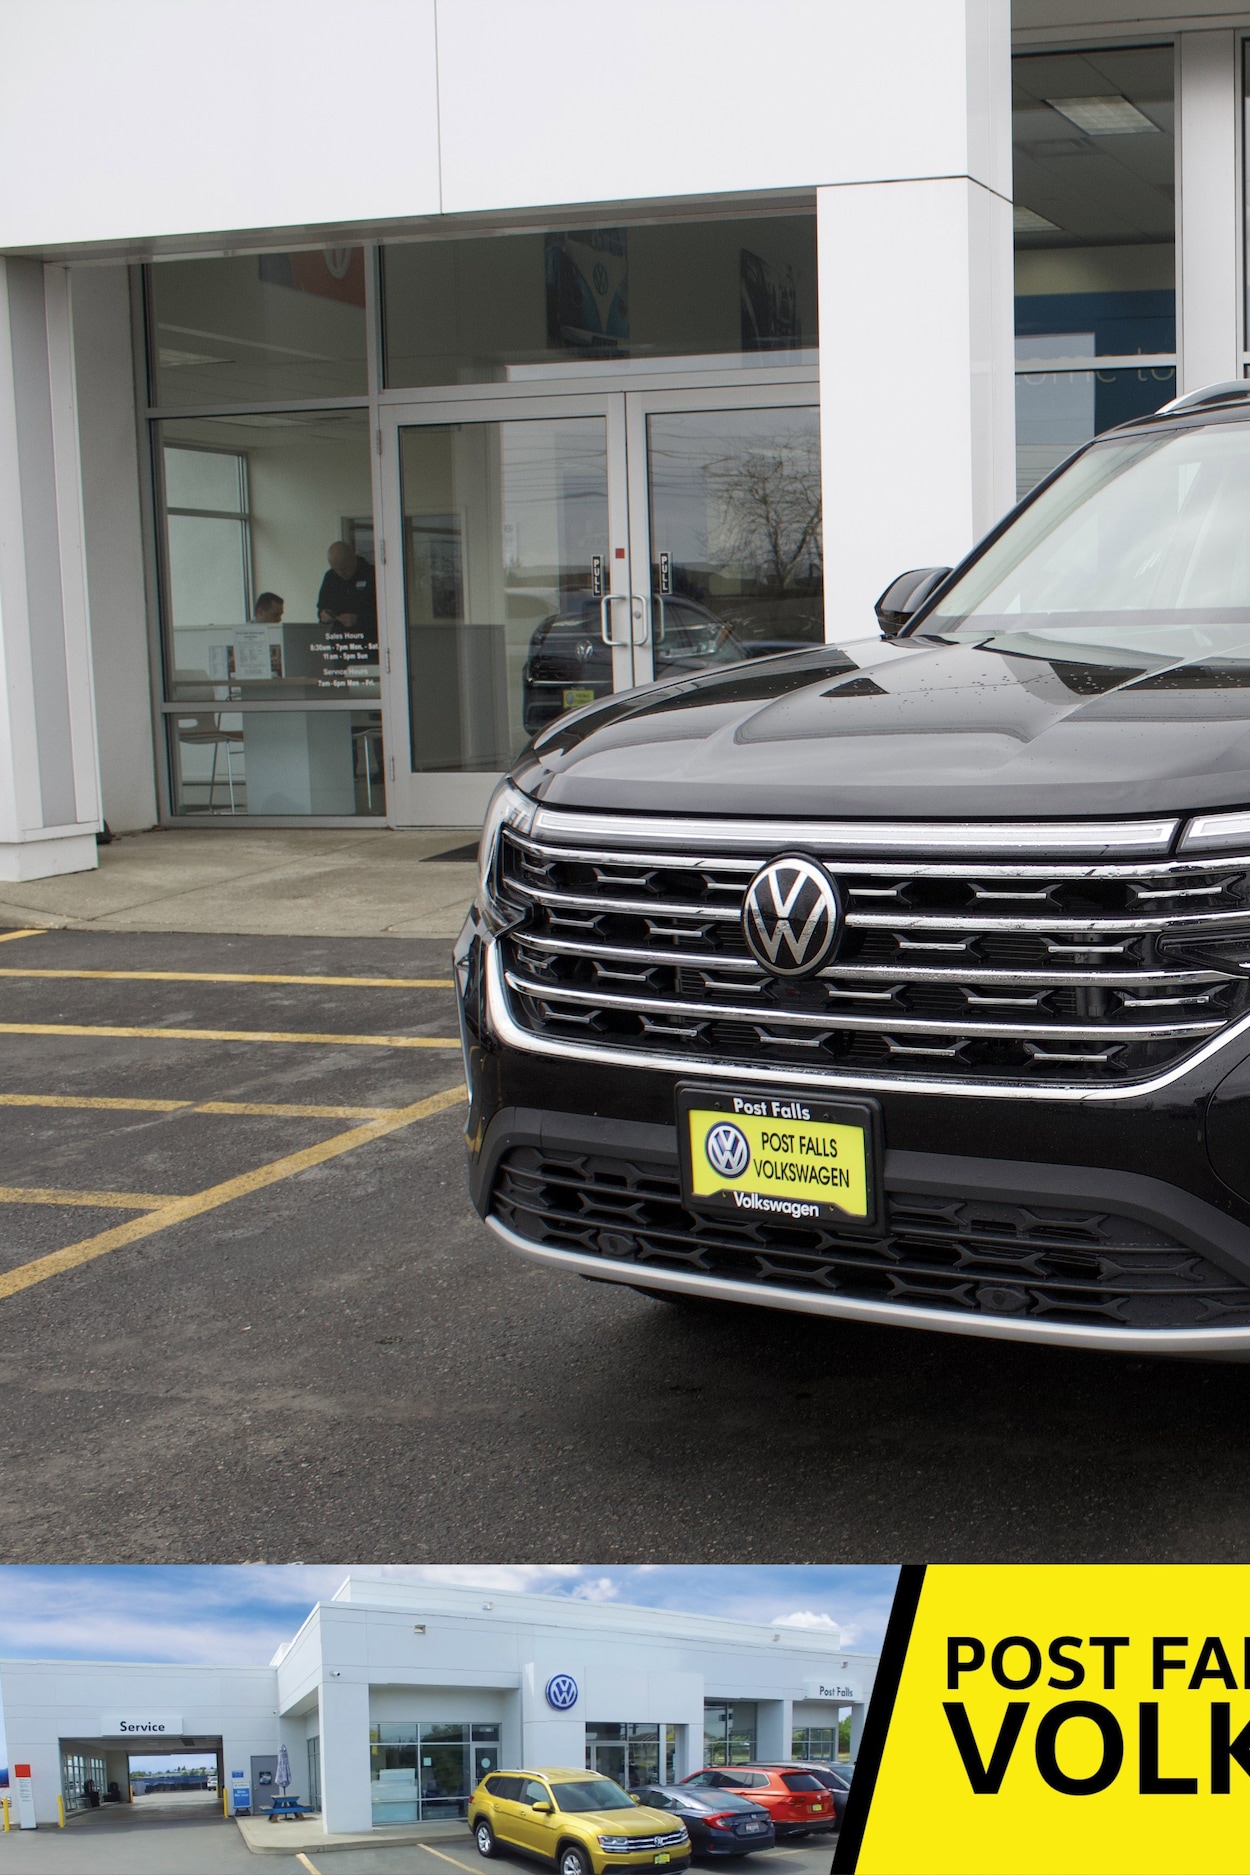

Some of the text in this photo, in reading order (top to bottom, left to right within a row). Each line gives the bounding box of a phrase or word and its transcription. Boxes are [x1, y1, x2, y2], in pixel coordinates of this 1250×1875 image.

[325, 632, 343, 640] Sales
[357, 652, 368, 660] Sun
[323, 668, 347, 676] Service
[733, 1098, 811, 1120] Post Falls
[762, 1132, 838, 1158] POST FALLS
[754, 1159, 850, 1188] VOLKSWAGEN
[733, 1191, 820, 1218] Volkswagen
[820, 1686, 853, 1697] Post Falls
[120, 1721, 165, 1732] Service
